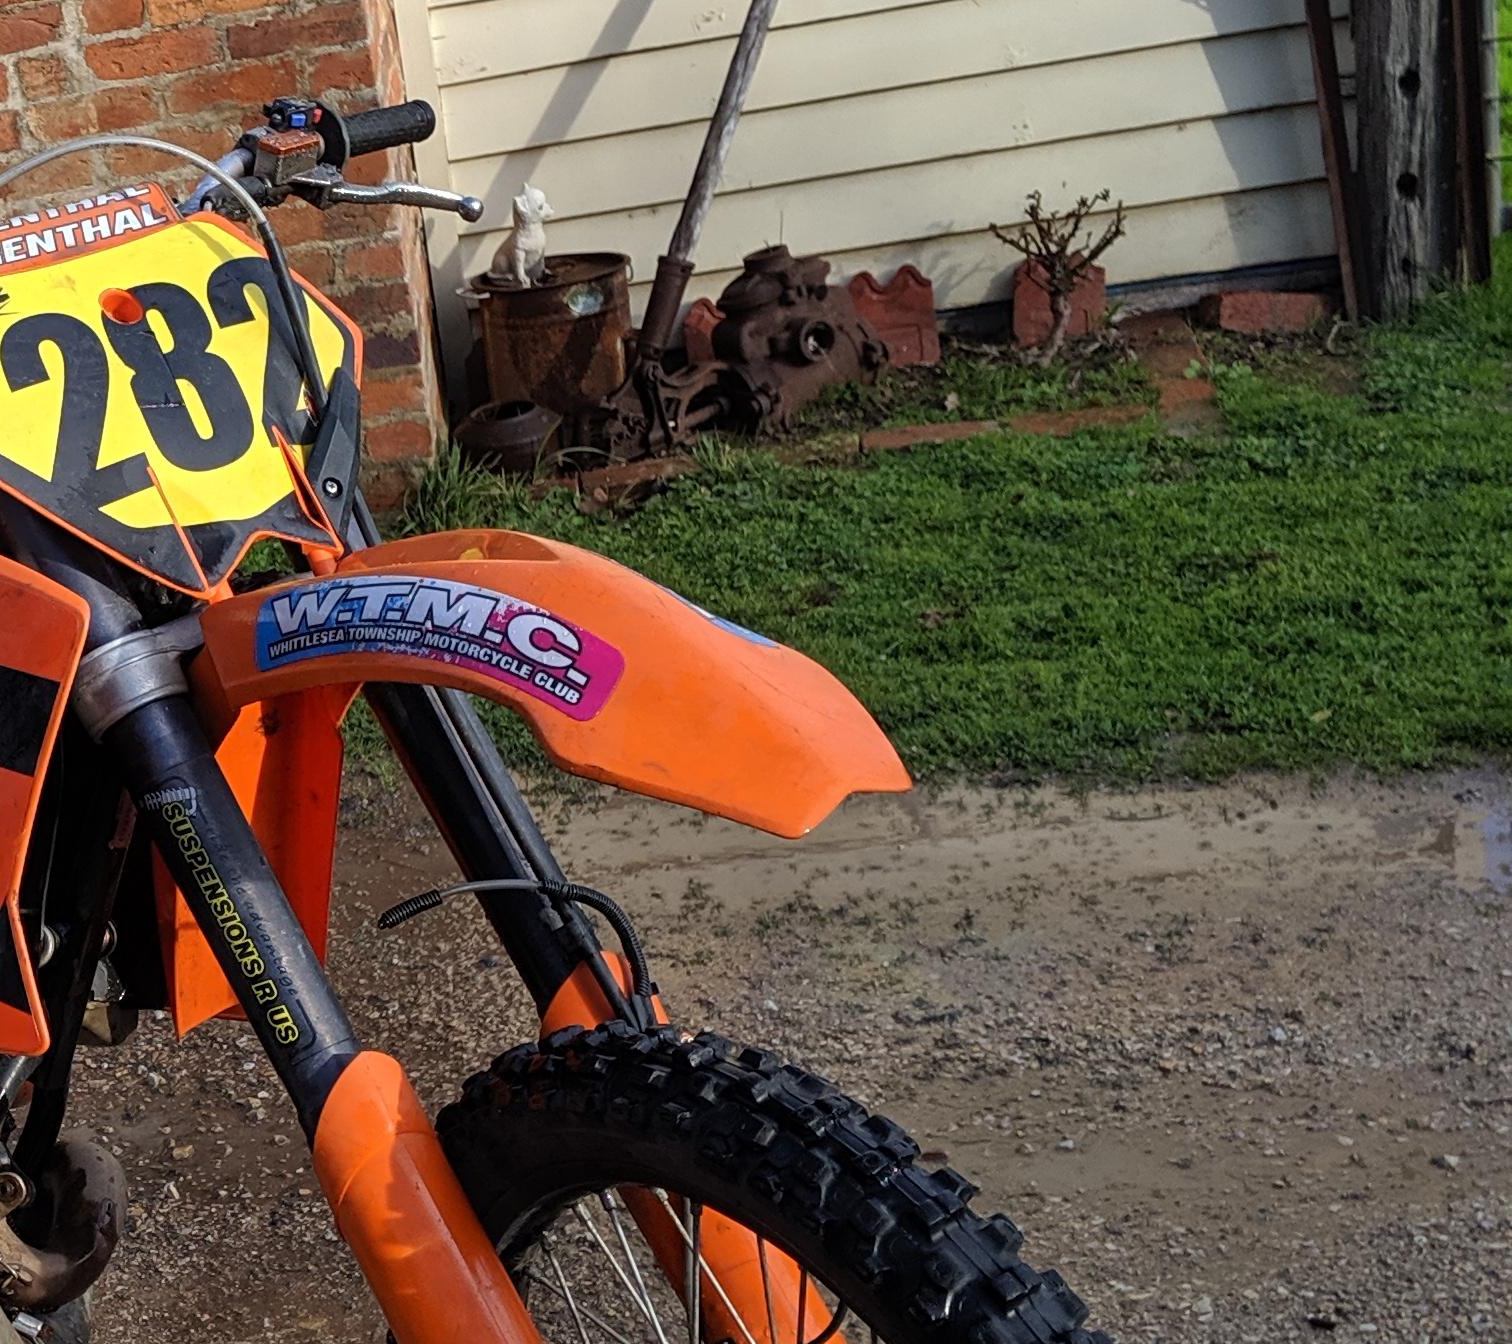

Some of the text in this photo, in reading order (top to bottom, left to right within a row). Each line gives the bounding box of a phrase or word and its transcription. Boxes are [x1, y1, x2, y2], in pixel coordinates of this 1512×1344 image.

[0, 256, 322, 512] 282
[269, 625, 580, 705] WHITTLESEA TOWNSHIP MOTORCYCLE CLUB
[162, 801, 299, 1045] SUSPENSIONS R US
